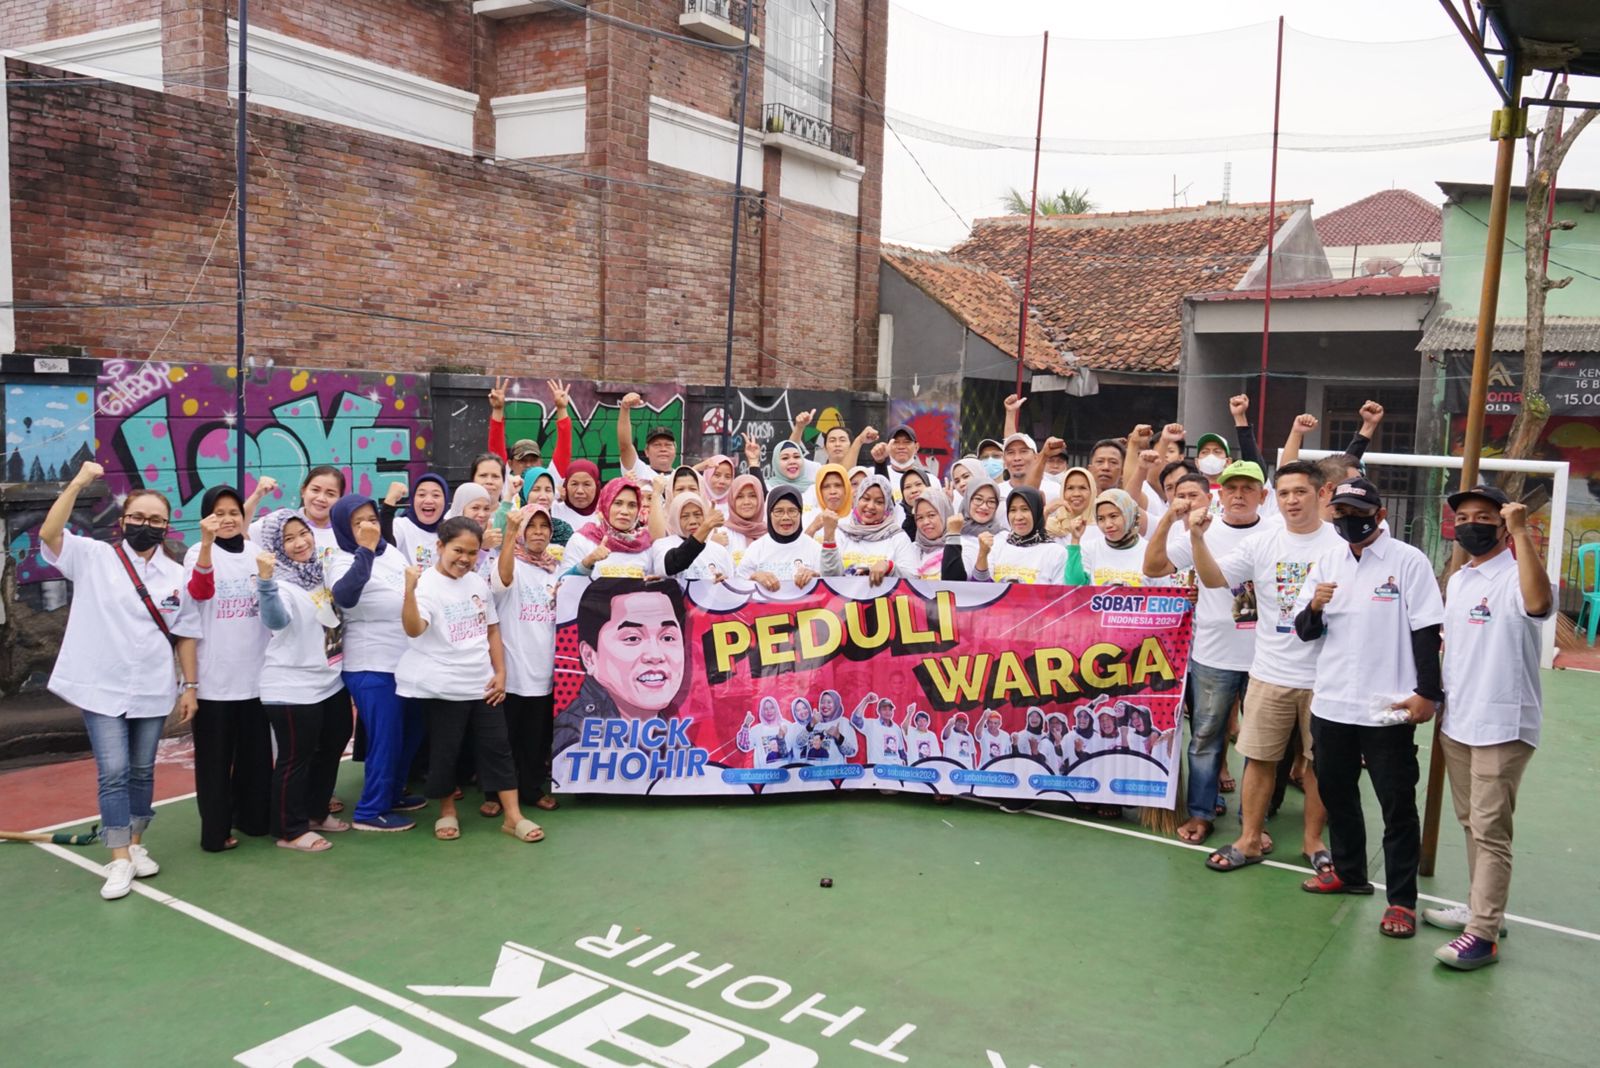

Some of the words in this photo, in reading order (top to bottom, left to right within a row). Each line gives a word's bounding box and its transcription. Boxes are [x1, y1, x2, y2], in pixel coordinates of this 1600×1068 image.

[1576, 380, 1588, 389] 16
[1485, 403, 1511, 412] OLD
[1486, 391, 1524, 403] oma
[1091, 595, 1145, 613] SOBAT
[1108, 615, 1153, 625] INDONESIA
[1155, 616, 1176, 625] 2024
[709, 591, 956, 676] PEDULI
[918, 636, 1177, 705] WARGA
[581, 717, 694, 748] ERICK
[565, 748, 709, 782] THOHIR
[575, 924, 916, 1063] THOHIR
